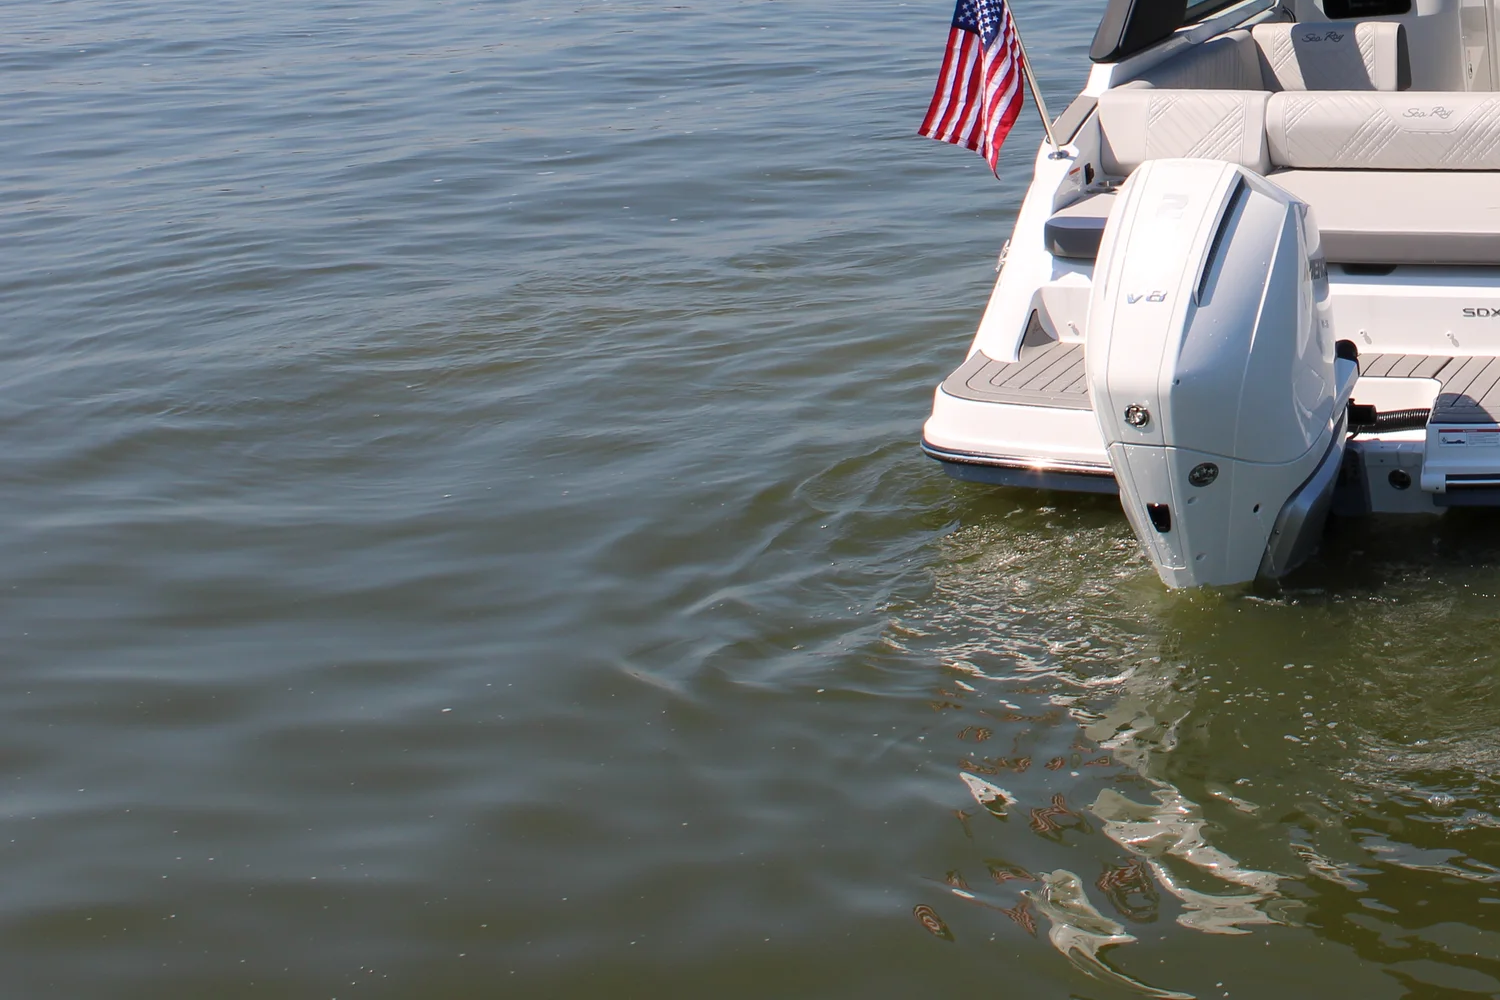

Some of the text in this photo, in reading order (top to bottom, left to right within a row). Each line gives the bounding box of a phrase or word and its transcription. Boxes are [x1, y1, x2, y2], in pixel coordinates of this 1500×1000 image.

[1301, 30, 1345, 43] Sea Ray
[1402, 105, 1454, 120] Sea Ray
